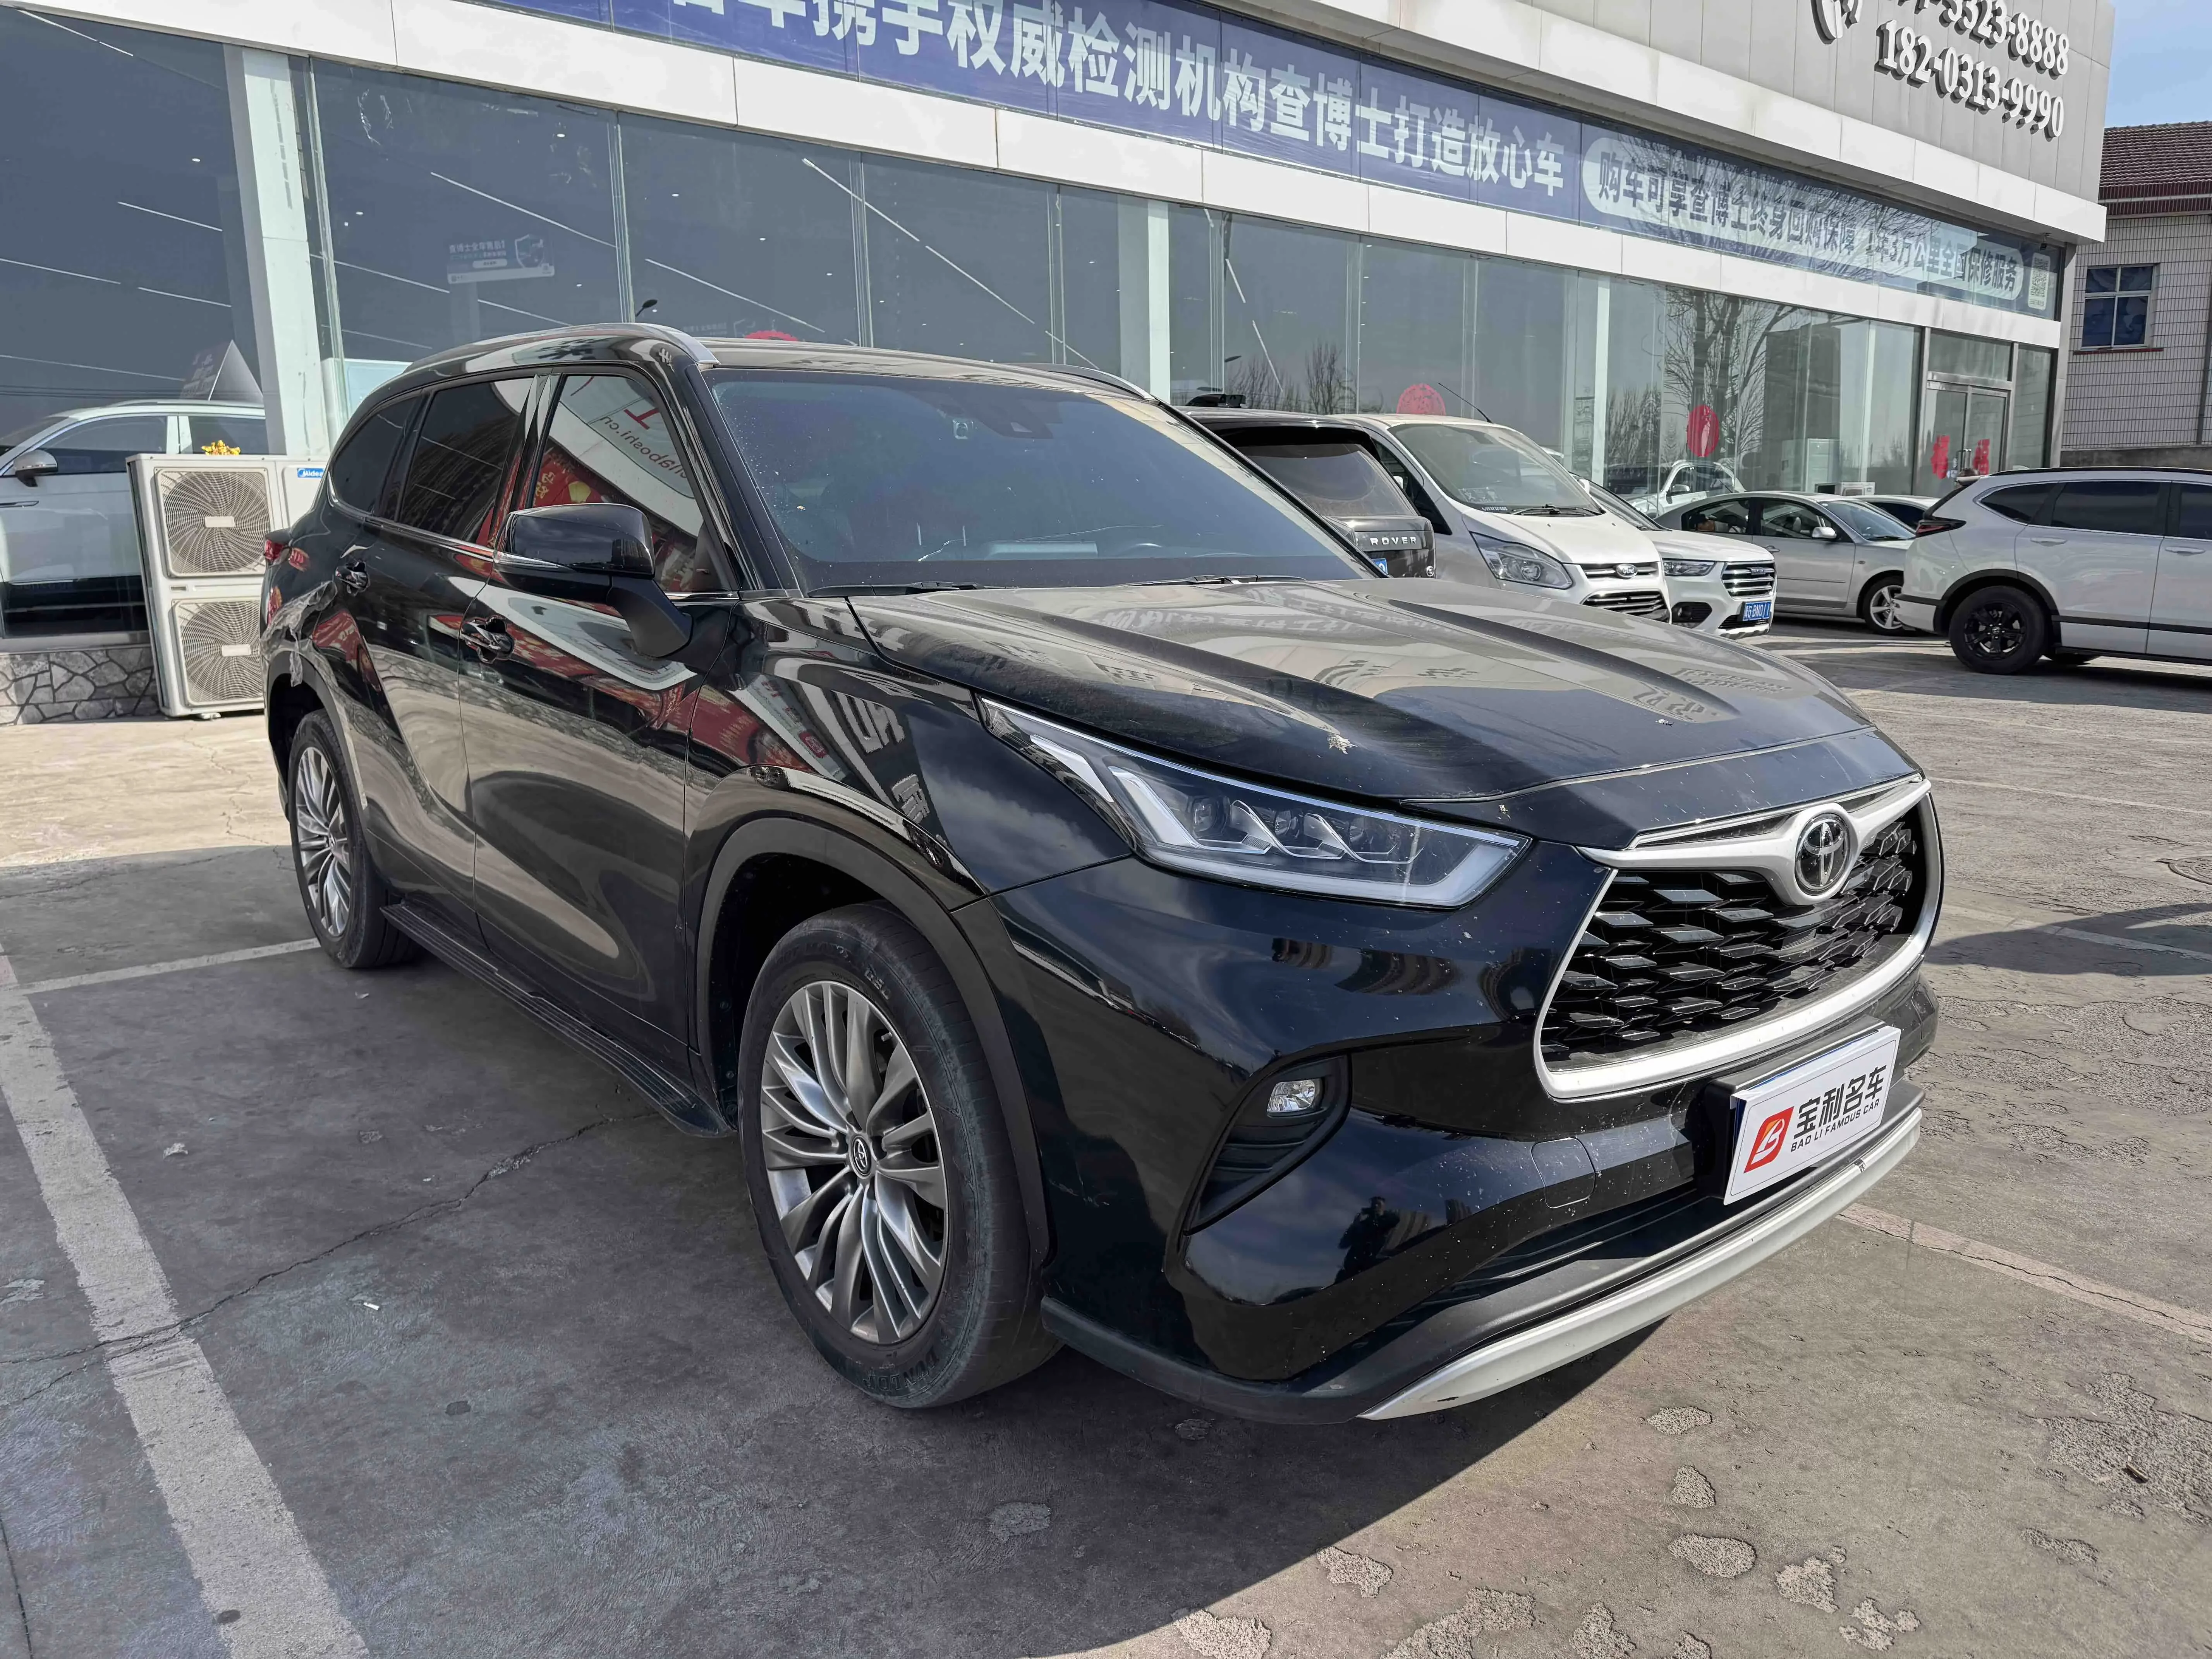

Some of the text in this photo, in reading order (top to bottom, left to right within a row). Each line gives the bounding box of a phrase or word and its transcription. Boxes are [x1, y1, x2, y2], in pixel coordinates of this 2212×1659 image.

[674, 0, 1565, 196] 携手权威检测机构查博士打造放心车
[1878, 19, 2064, 138] 182-0313-9990
[1370, 536, 1416, 546] ROVER
[1790, 1099, 1880, 1152] BAO LI FAMOUS CAR
[1793, 1064, 1887, 1139] 宝利名车
